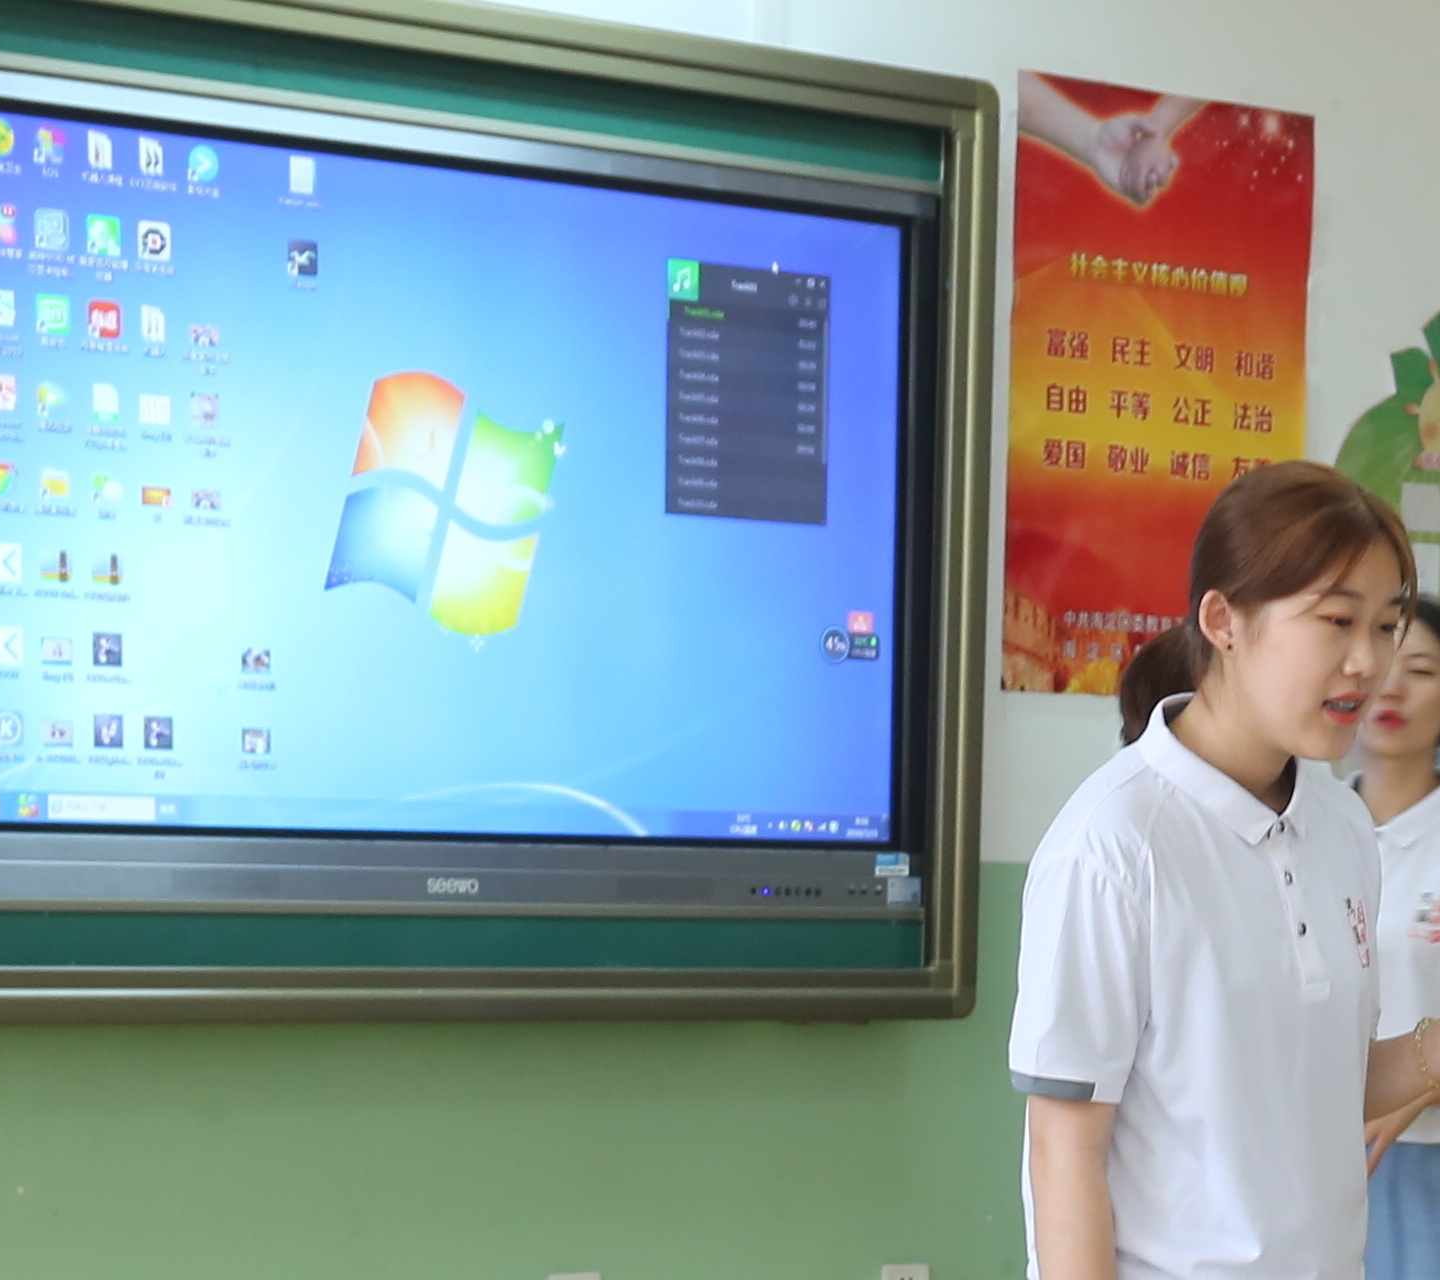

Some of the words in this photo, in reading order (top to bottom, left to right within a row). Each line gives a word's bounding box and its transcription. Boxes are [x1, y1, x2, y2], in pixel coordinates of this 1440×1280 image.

[1070, 251, 1248, 297] 社会主义核心价值观
[1047, 328, 1089, 360] 富强
[1112, 337, 1151, 367] 民主
[1174, 343, 1214, 373] 文明
[1235, 351, 1275, 380] 和谐
[1046, 383, 1087, 414] 自由
[1110, 390, 1151, 421] 平等
[1172, 396, 1212, 427] 公正
[1233, 402, 1272, 433] 法治
[1044, 438, 1085, 470] 爱国
[1108, 444, 1149, 475] 敬业
[1170, 451, 1210, 481] 诚信
[1232, 456, 1270, 480] 友
[1063, 640, 1143, 661] 海淀区
